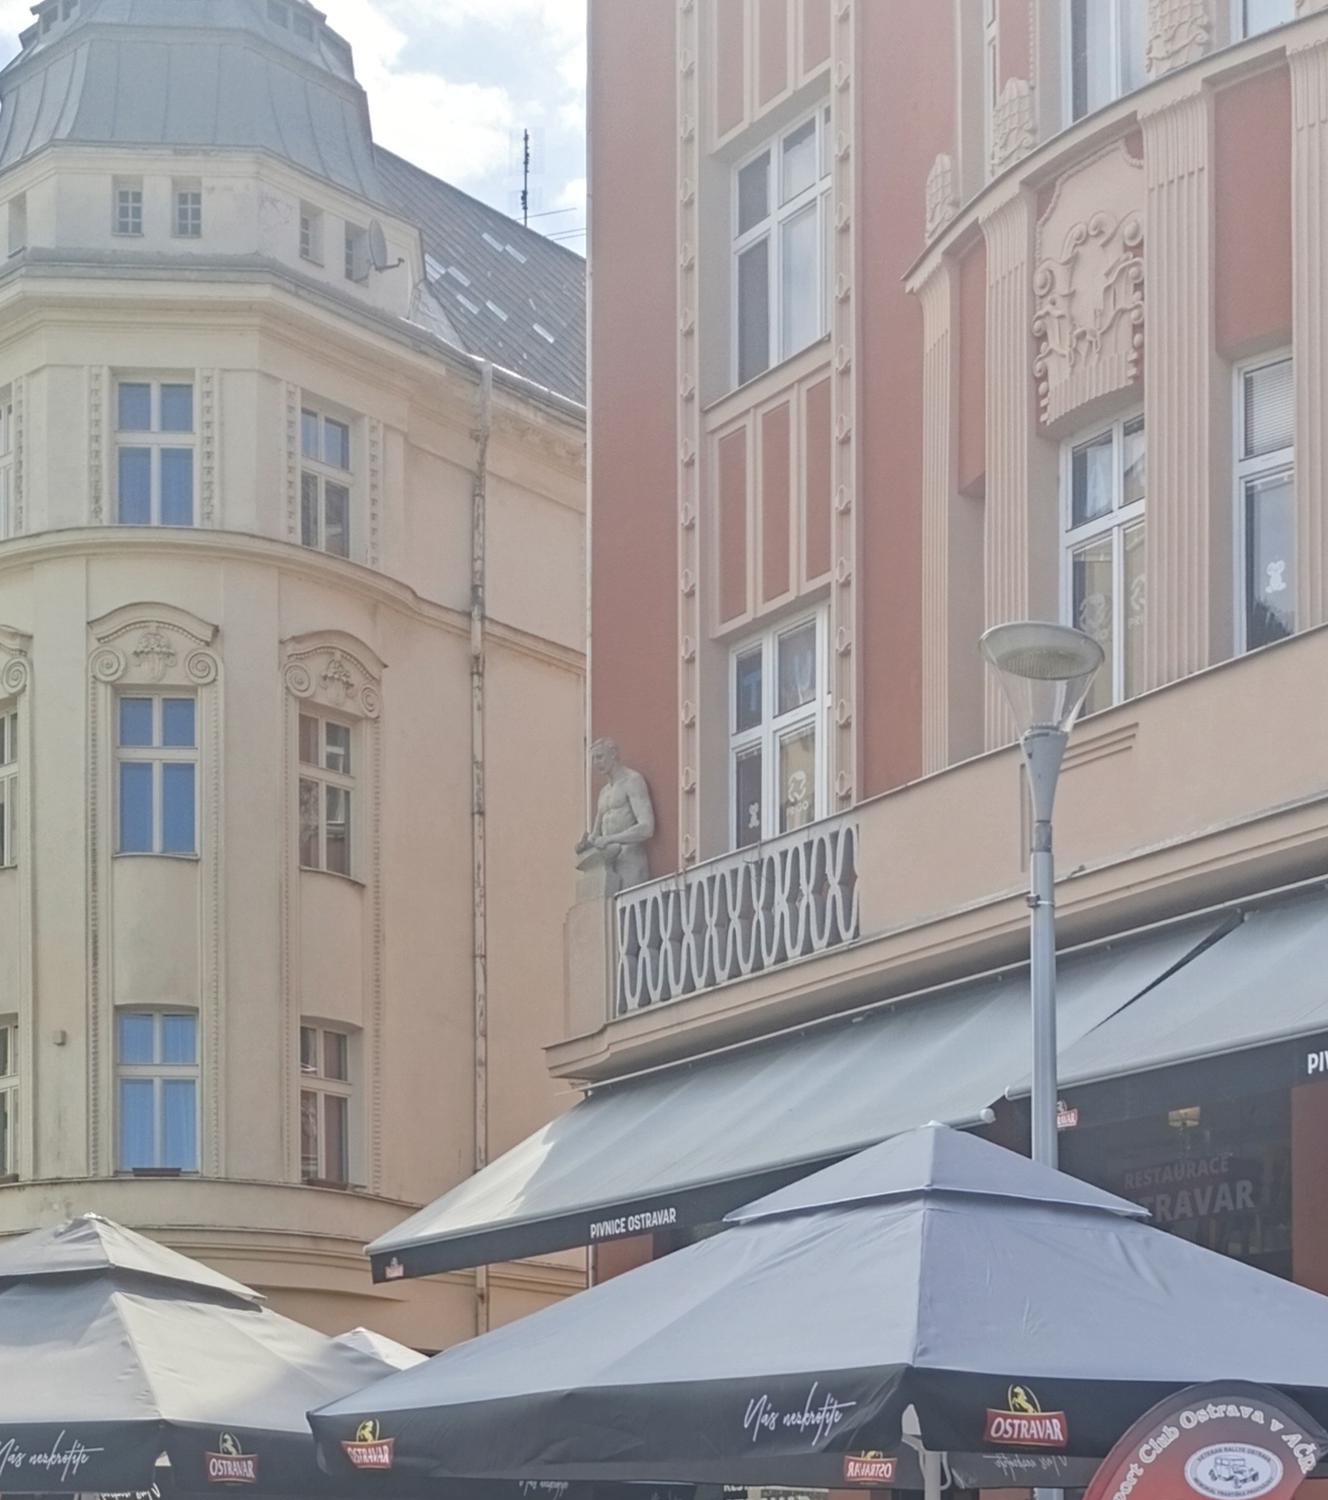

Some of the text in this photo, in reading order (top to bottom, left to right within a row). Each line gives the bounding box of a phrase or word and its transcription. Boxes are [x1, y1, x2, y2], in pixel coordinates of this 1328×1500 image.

[1124, 1154, 1230, 1190] RESTAURACE
[590, 1207, 677, 1239] PIVNICE OSTRAVAR
[989, 1416, 1062, 1442] OSTRAVAR
[1138, 1424, 1181, 1465] Club
[1178, 1403, 1266, 1430] Ostrava
[1270, 1418, 1284, 1433] v
[1281, 1432, 1318, 1475] AČR
[208, 1457, 256, 1480] OSTRAVAR
